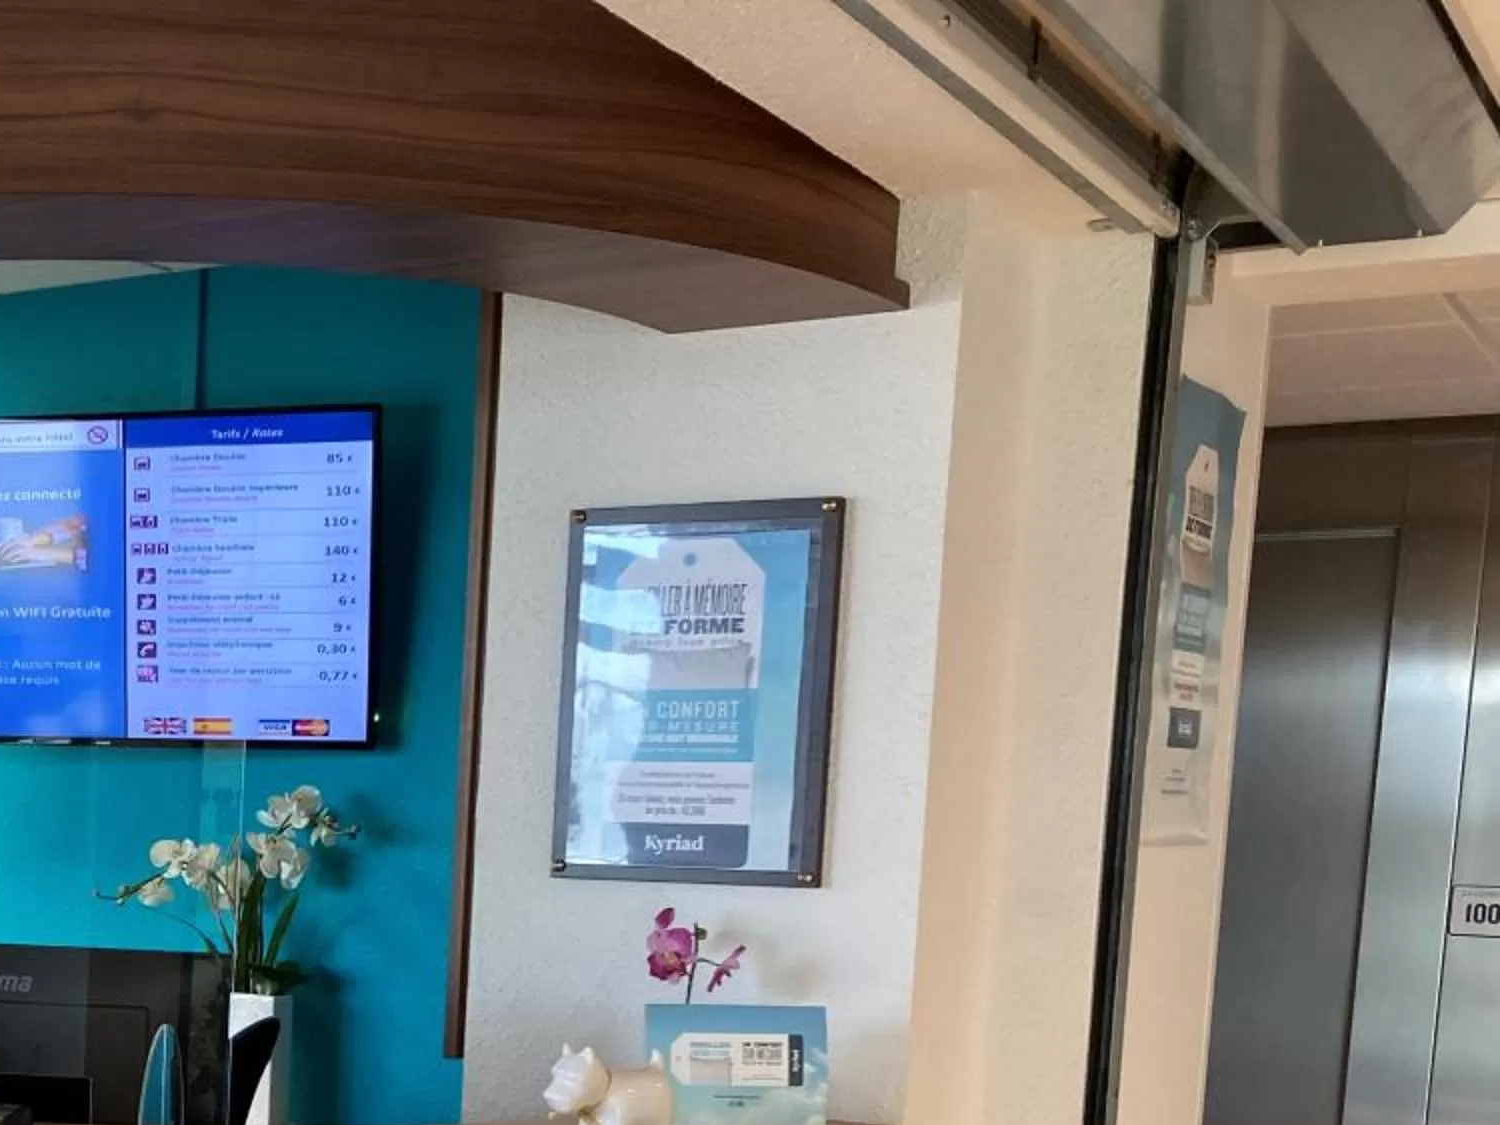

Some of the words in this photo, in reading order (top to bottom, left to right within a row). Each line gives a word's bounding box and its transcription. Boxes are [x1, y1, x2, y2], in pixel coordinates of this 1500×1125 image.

[327, 453, 343, 464] 85
[326, 485, 352, 497] 110
[324, 516, 349, 528] 110
[324, 545, 350, 556] 140
[331, 572, 348, 583] 12
[51, 606, 112, 619] Gratuite
[663, 617, 746, 635] FORME
[656, 700, 741, 719] CONFORT
[643, 833, 705, 855] Kyriad
